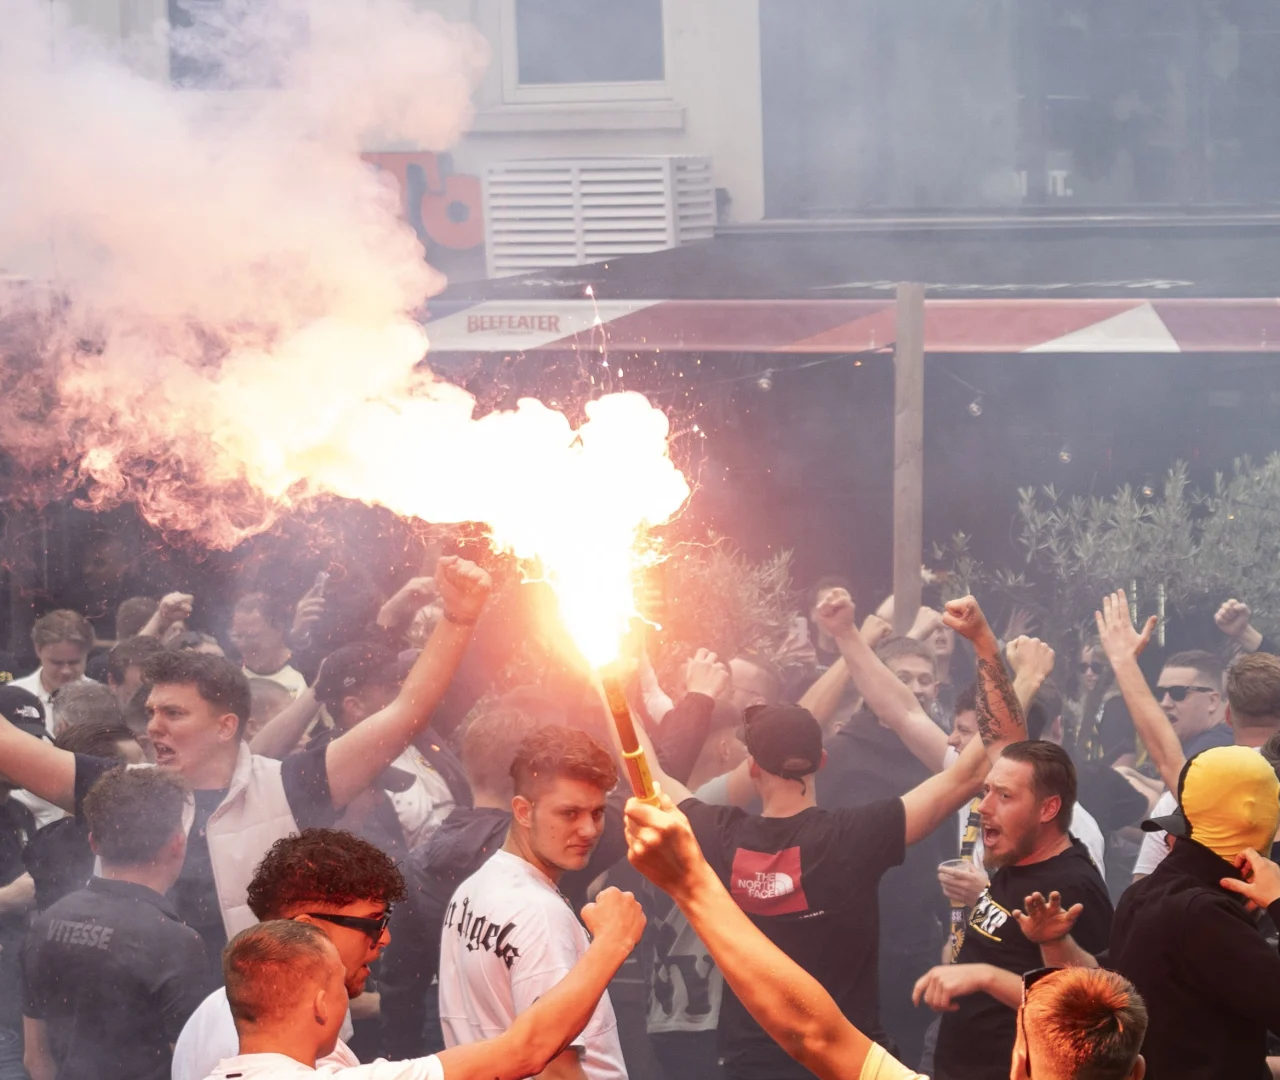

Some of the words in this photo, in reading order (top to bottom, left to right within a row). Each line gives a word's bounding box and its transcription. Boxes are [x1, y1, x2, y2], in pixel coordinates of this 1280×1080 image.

[467, 315, 561, 334] BEEFEATER
[755, 871, 776, 882] THE
[738, 879, 775, 890] NORTH
[748, 889, 776, 899] FACE
[46, 918, 114, 950] VITESSE
